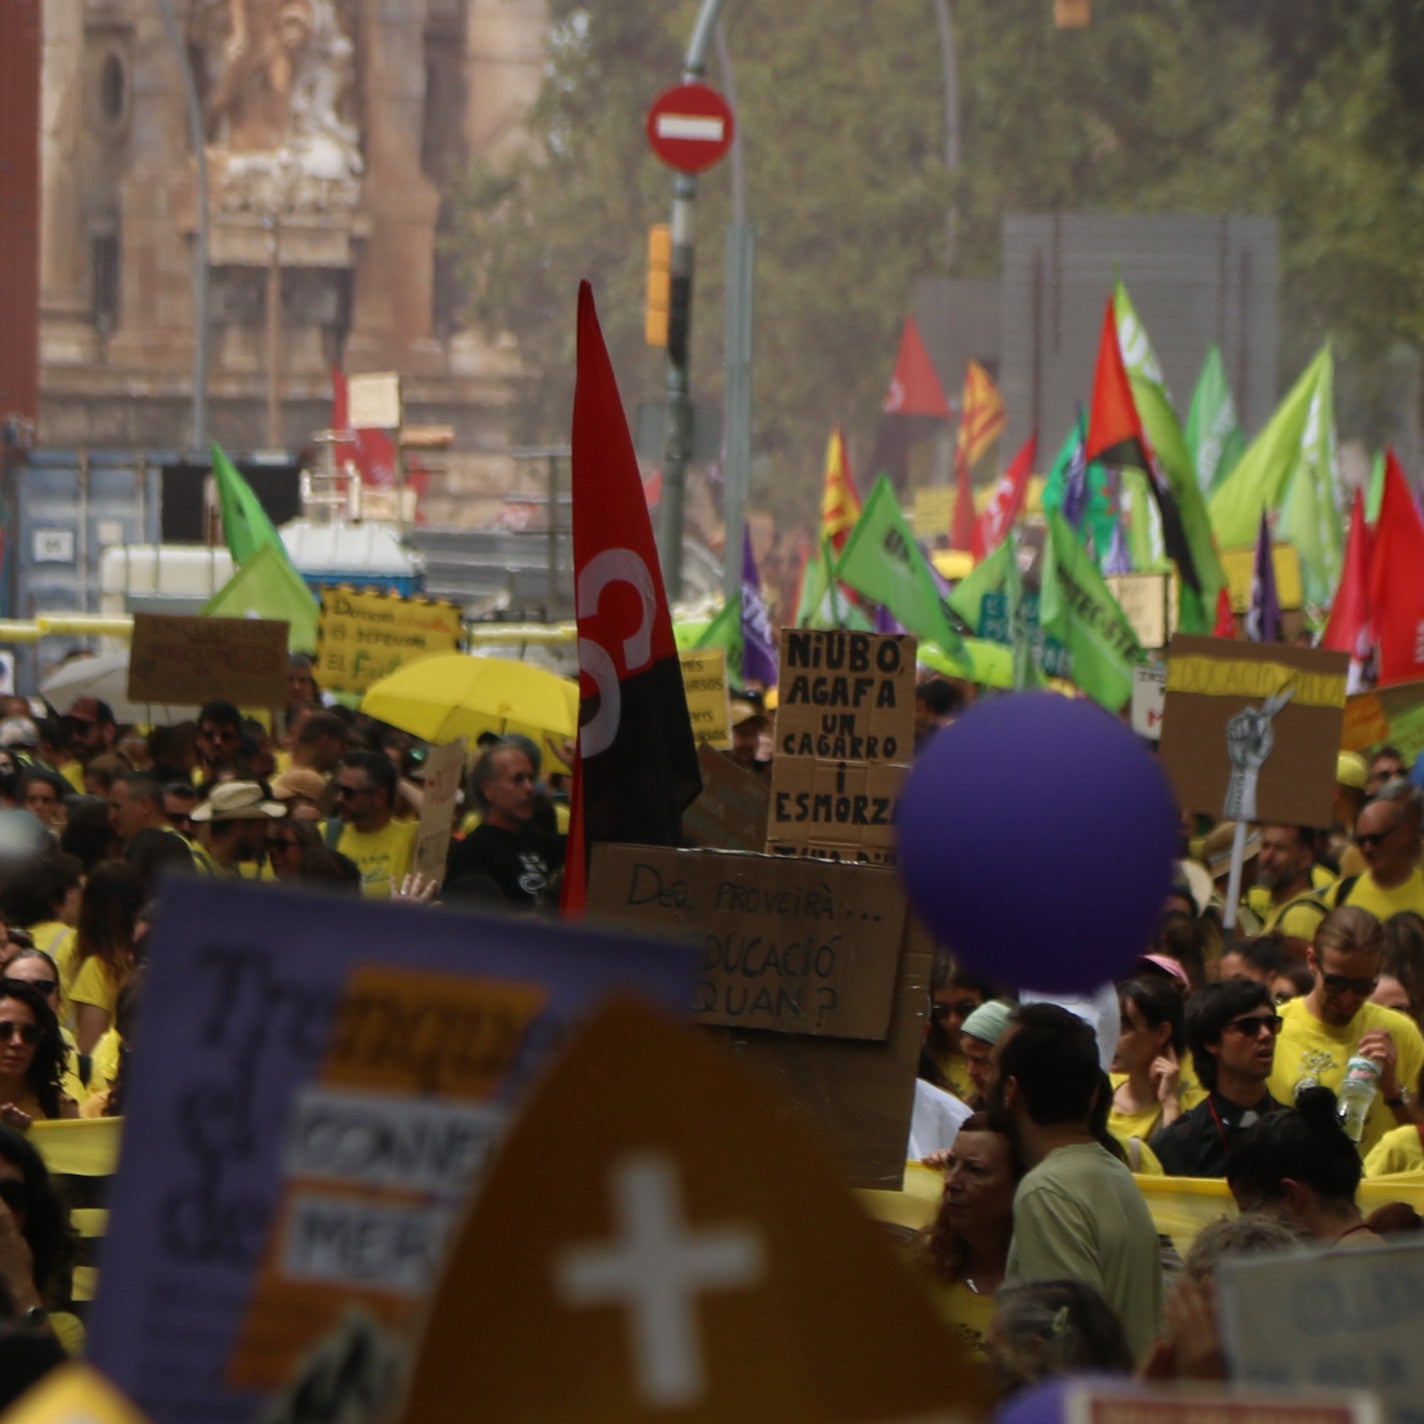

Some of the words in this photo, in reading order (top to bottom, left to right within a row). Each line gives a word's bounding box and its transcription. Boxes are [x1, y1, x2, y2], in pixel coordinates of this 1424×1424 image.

[786, 676, 896, 709] AGAFA
[822, 713, 856, 737] UN
[783, 732, 898, 760] CAGARRO
[776, 791, 892, 826] ESMORZ
